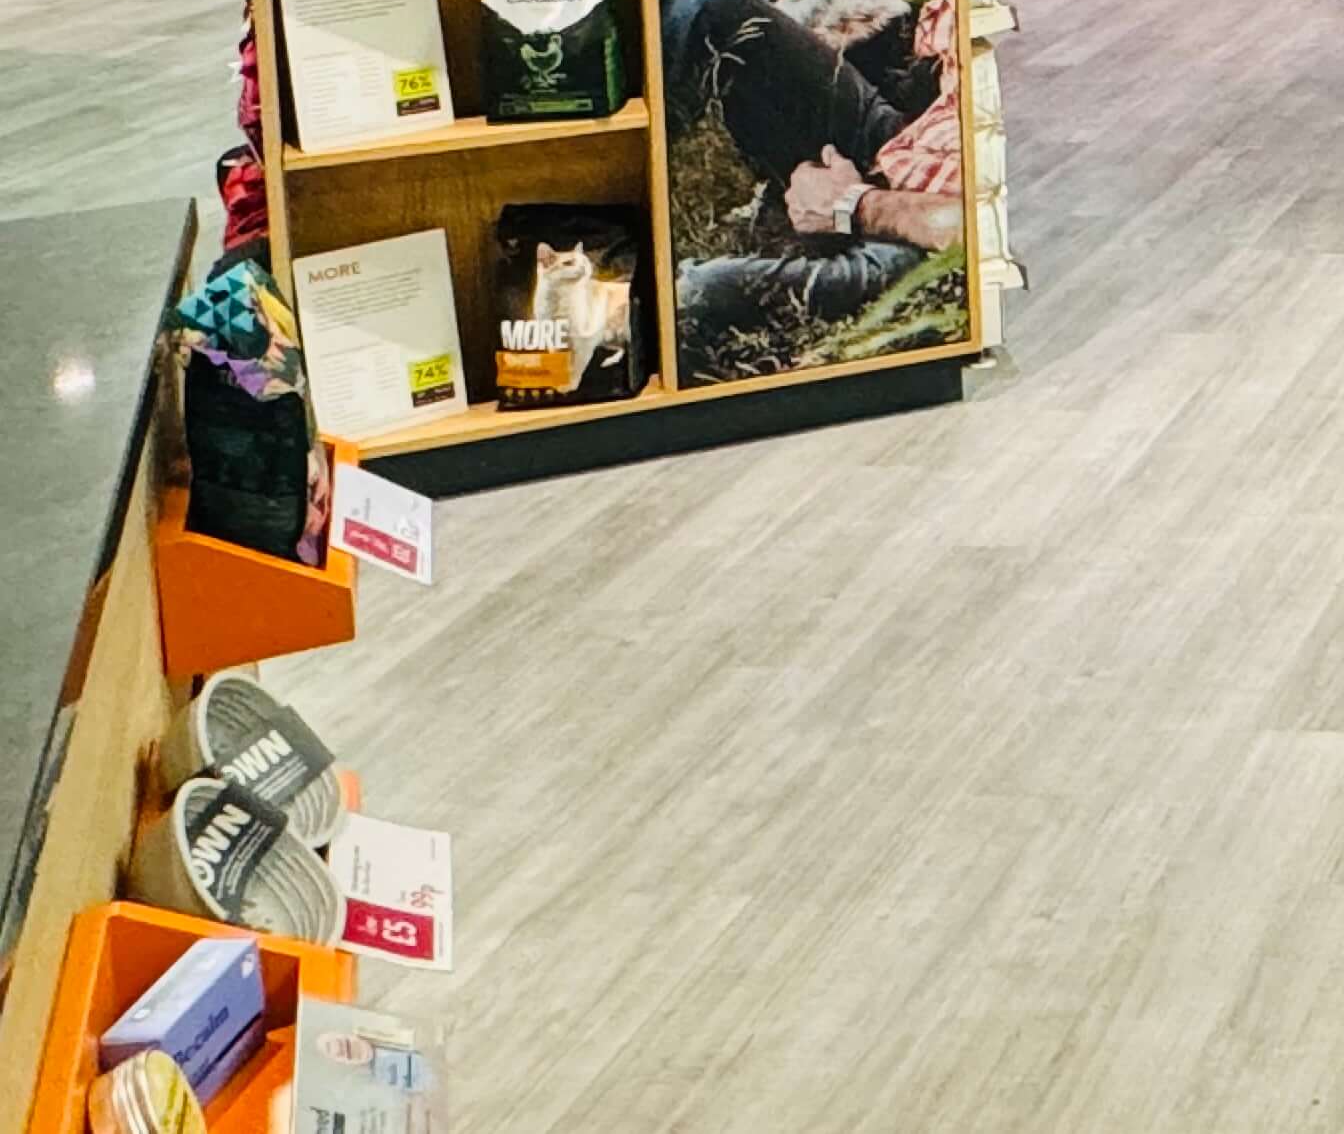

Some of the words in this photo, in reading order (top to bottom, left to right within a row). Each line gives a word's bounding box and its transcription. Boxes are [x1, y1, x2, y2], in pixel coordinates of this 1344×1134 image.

[307, 261, 360, 284] MORE
[501, 319, 569, 351] MORE
[381, 917, 418, 948] £5
